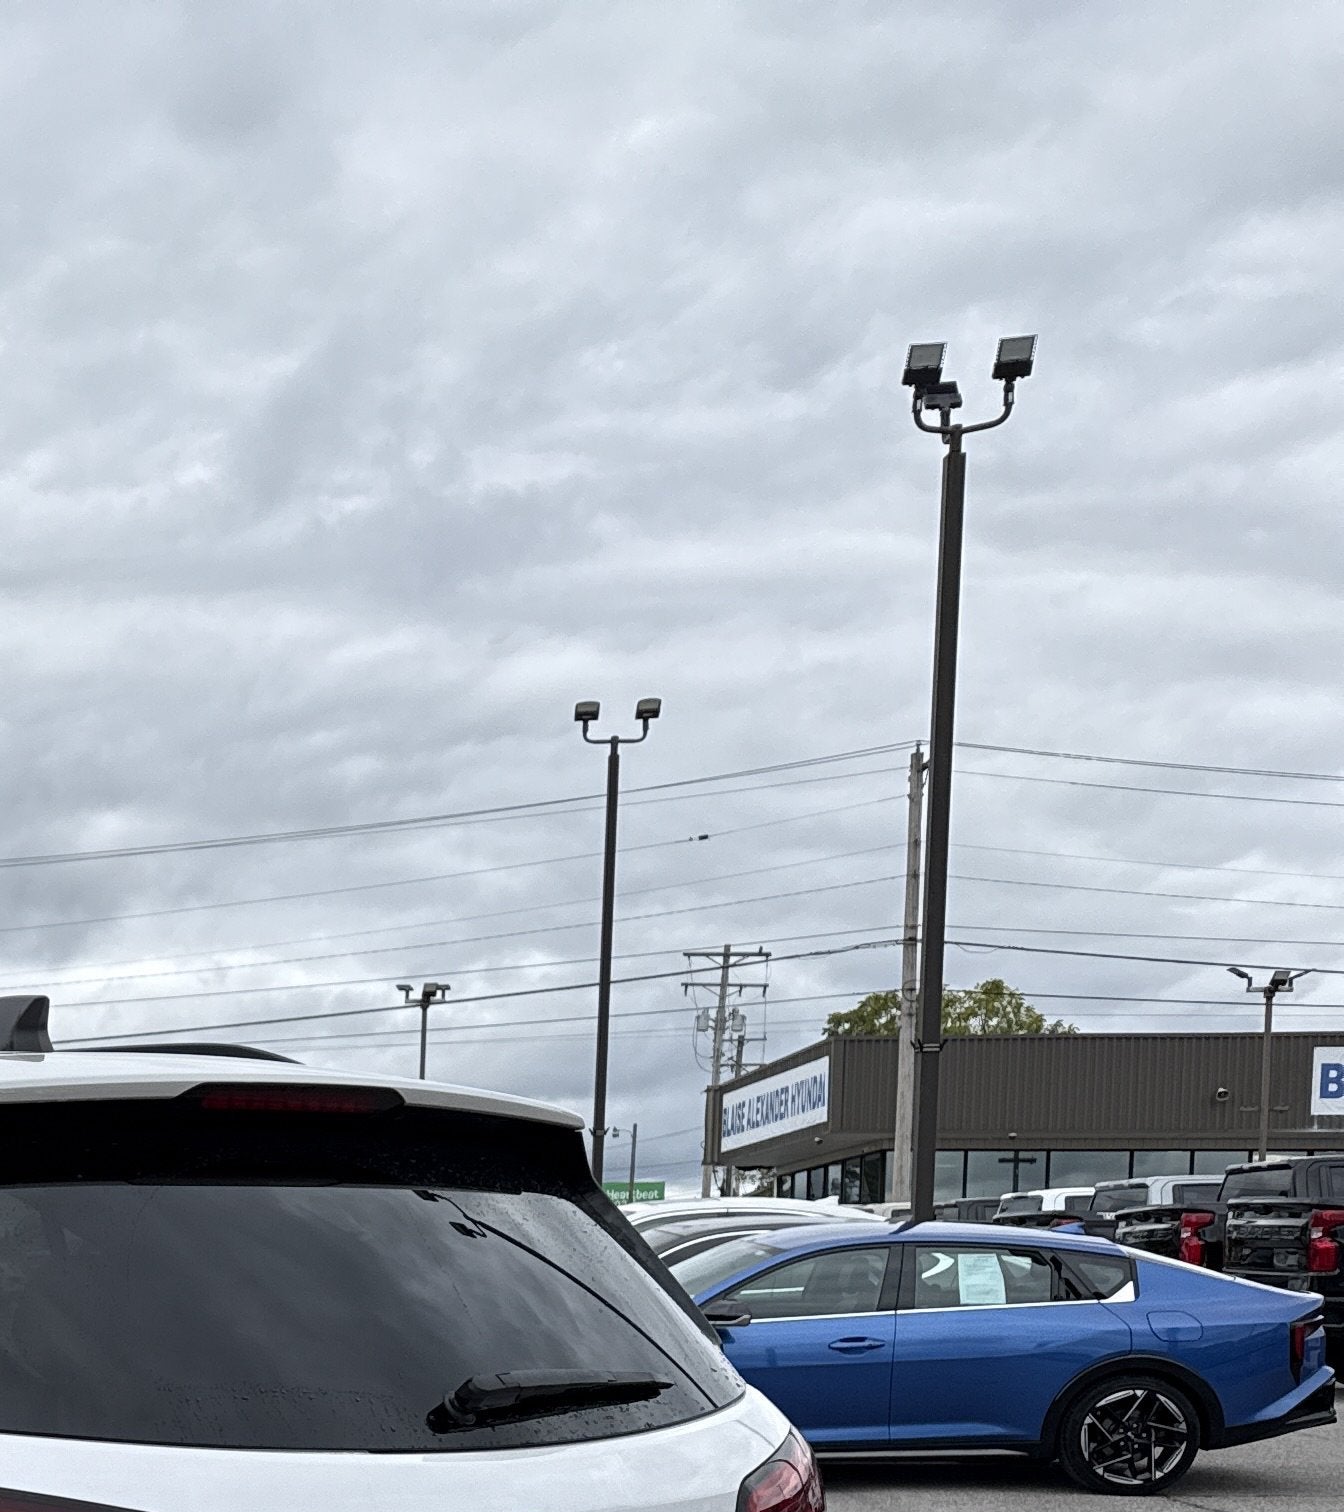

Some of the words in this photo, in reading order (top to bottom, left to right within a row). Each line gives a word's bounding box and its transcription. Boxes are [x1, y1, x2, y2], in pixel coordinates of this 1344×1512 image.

[722, 1101, 745, 1138] BLAISE
[746, 1085, 790, 1132] ALEXANDER
[791, 1072, 826, 1117] HYUNDAI
